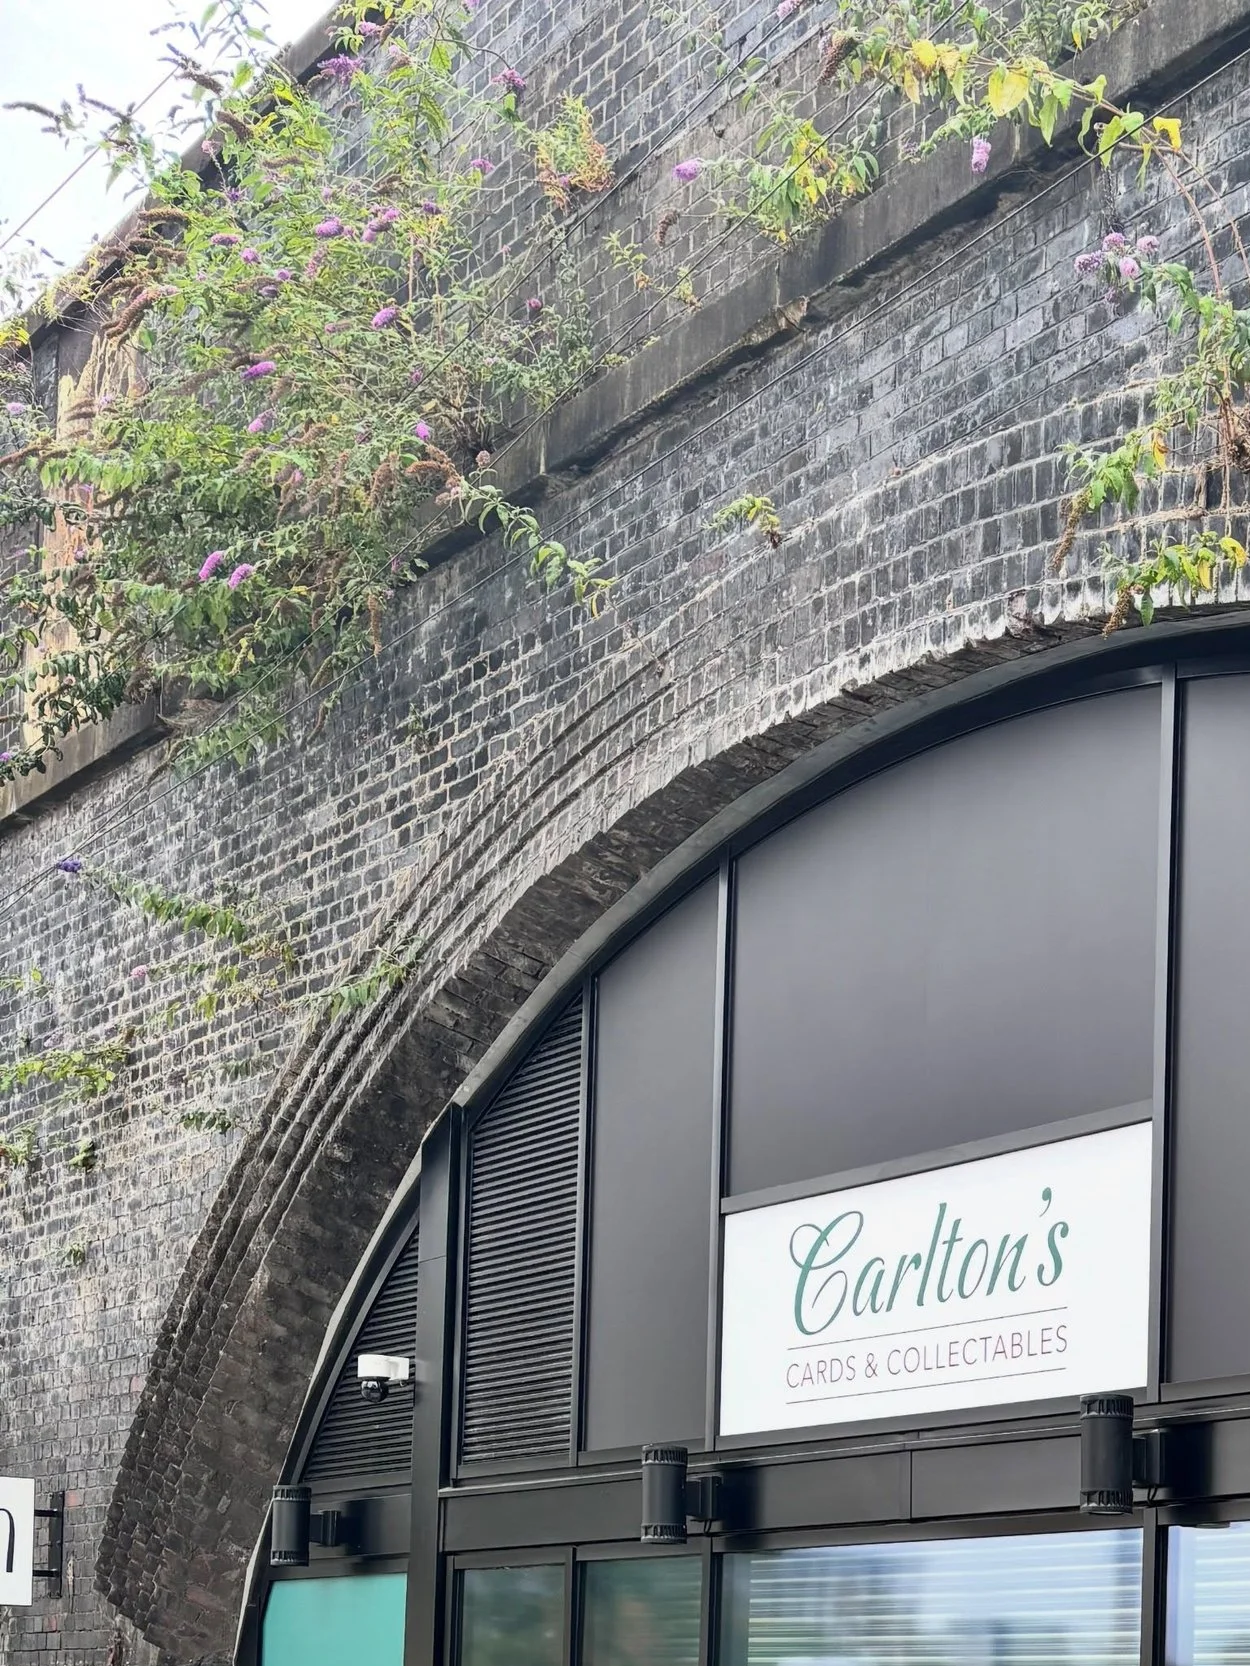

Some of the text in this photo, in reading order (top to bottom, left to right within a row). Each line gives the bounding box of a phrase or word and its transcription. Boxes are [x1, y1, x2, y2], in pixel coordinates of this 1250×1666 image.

[789, 1187, 1069, 1336] Carlton's
[785, 1324, 1069, 1389] CARDS & COLLECTABLES
